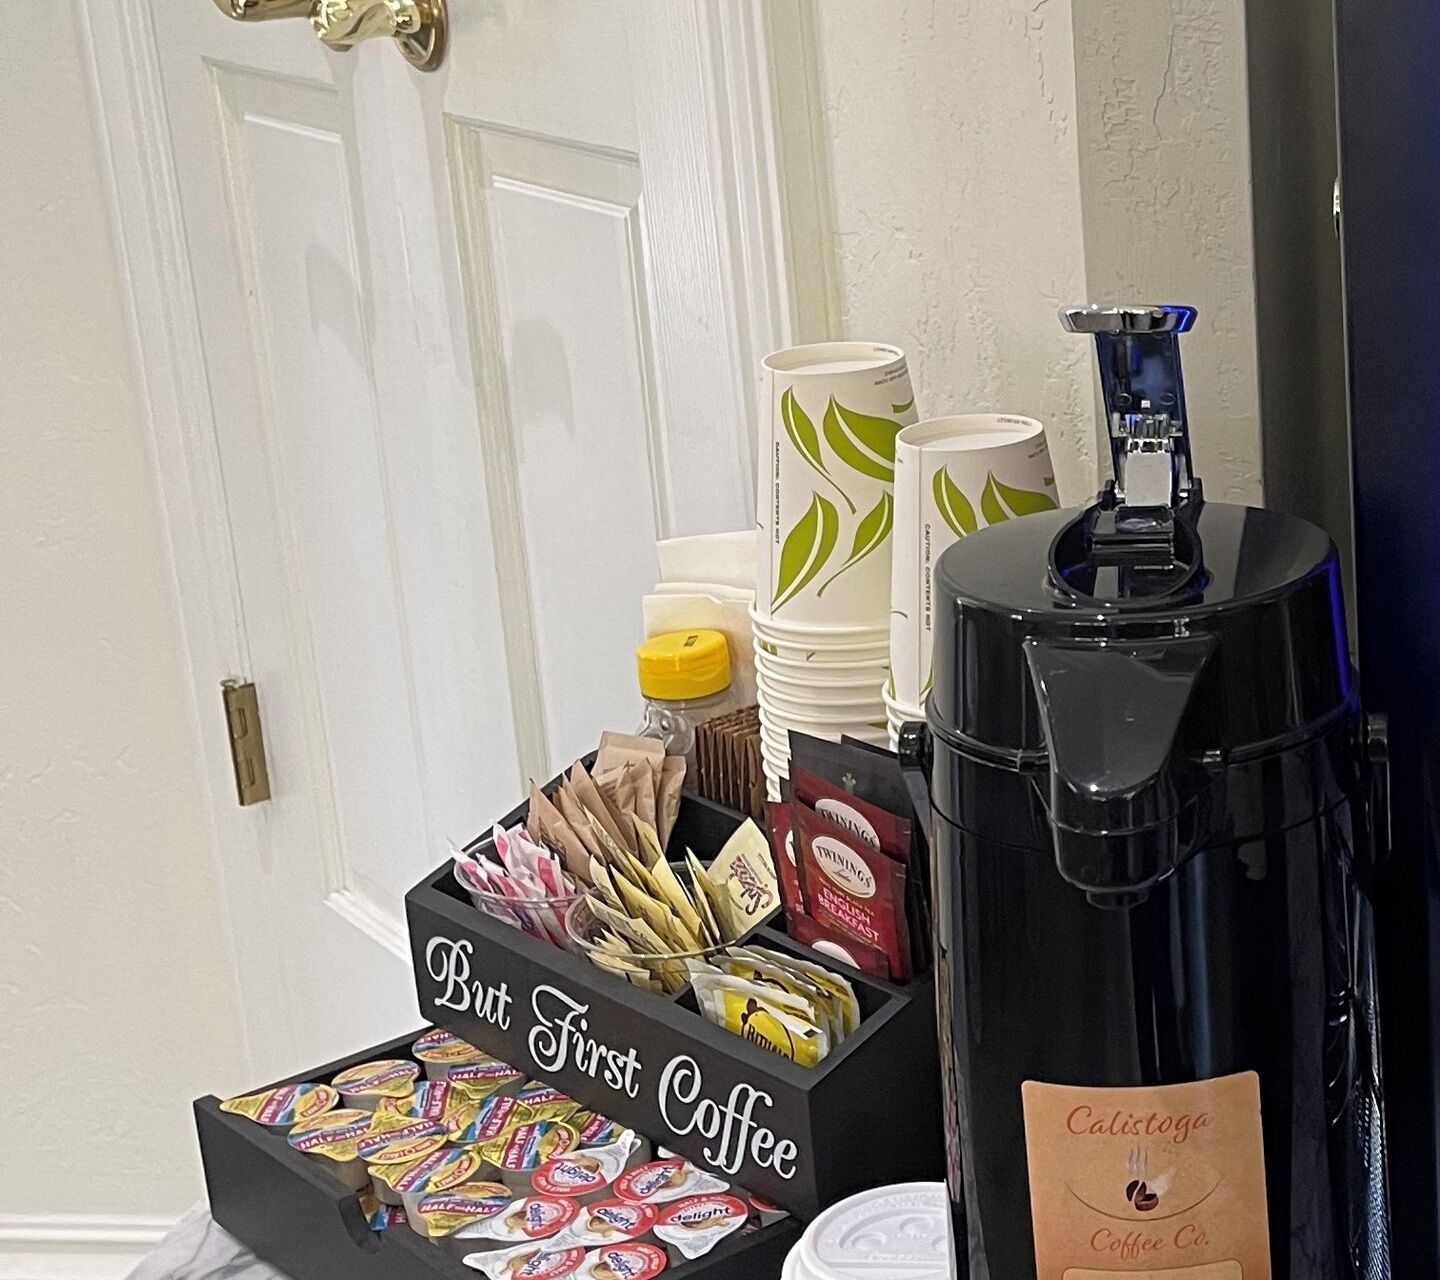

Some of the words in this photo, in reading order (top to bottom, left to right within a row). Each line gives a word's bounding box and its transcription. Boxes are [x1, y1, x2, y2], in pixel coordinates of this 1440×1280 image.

[815, 845, 872, 889] TWININGS
[818, 893, 880, 942] BREAKFAST
[823, 887, 871, 924] ENGLISH
[425, 936, 513, 1031] But
[528, 984, 643, 1099] First
[658, 1054, 799, 1180] Coffee
[451, 1072, 484, 1082] HALF
[494, 1070, 519, 1078] HAL
[300, 1136, 332, 1149] HALF
[345, 1127, 368, 1138] HAL
[1066, 1105, 1209, 1144] Calistoga
[555, 1162, 596, 1183] delight
[421, 1203, 453, 1212] HALF
[464, 1204, 498, 1213] HALF
[597, 1208, 637, 1230] delight
[671, 1206, 731, 1223] delight
[1090, 1227, 1164, 1259] Coffee
[1173, 1223, 1209, 1251] Co.
[607, 1251, 637, 1280] delight
